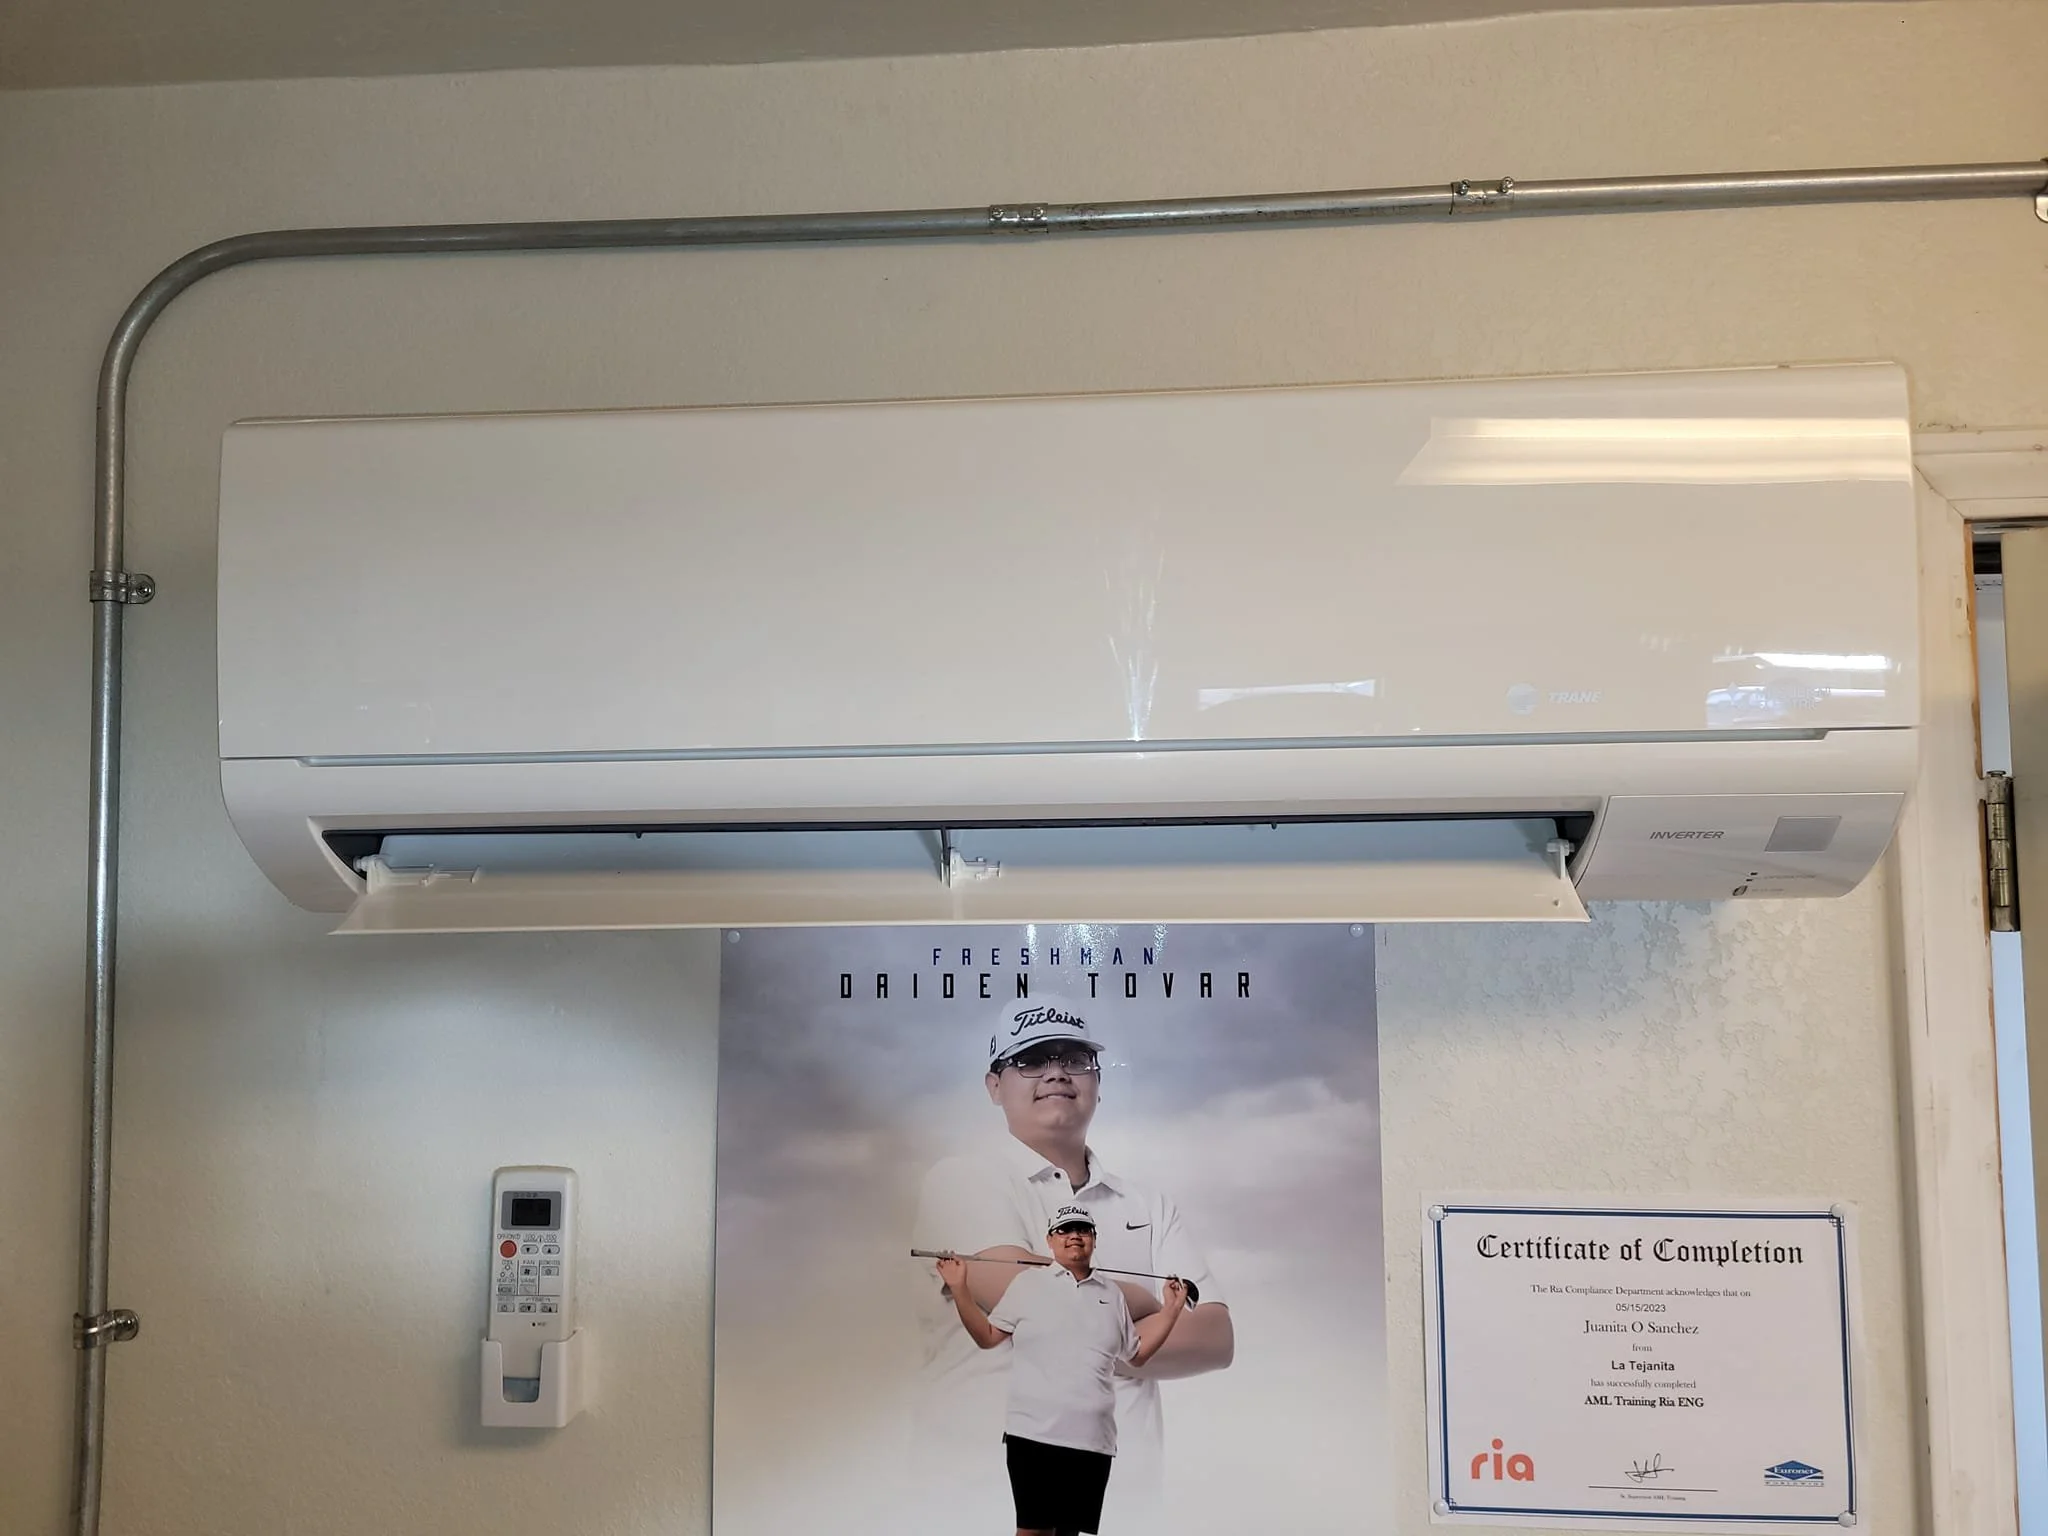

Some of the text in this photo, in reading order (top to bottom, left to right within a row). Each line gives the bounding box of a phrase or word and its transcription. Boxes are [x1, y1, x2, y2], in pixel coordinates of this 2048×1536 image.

[1548, 690, 1602, 703] TRANE
[1650, 831, 1725, 840] INVERTER
[933, 947, 1154, 966] FRESHMAN
[1087, 972, 1250, 998] TOVAR
[1011, 1006, 1085, 1036] Titleist
[1056, 1205, 1089, 1220] Titleist
[1477, 1234, 1804, 1267] Certificate of Completion
[1531, 1285, 1547, 1294] The
[1550, 1286, 1563, 1294] Ria
[1565, 1286, 1613, 1297] Compliance
[1615, 1287, 1664, 1297] Department
[1665, 1287, 1721, 1298] acknowledges
[1723, 1289, 1738, 1297] that
[1615, 1303, 1666, 1313] 05/15/2023
[1583, 1320, 1699, 1335] Juanita O Sanchez
[1632, 1343, 1653, 1352] from
[1611, 1360, 1675, 1373] La Tejanita
[1590, 1379, 1697, 1390] has successfully completed
[1584, 1396, 1705, 1409] AML Training Ria ENG
[1471, 1438, 1535, 1481] ria
[1774, 1466, 1814, 1475] Euronet
